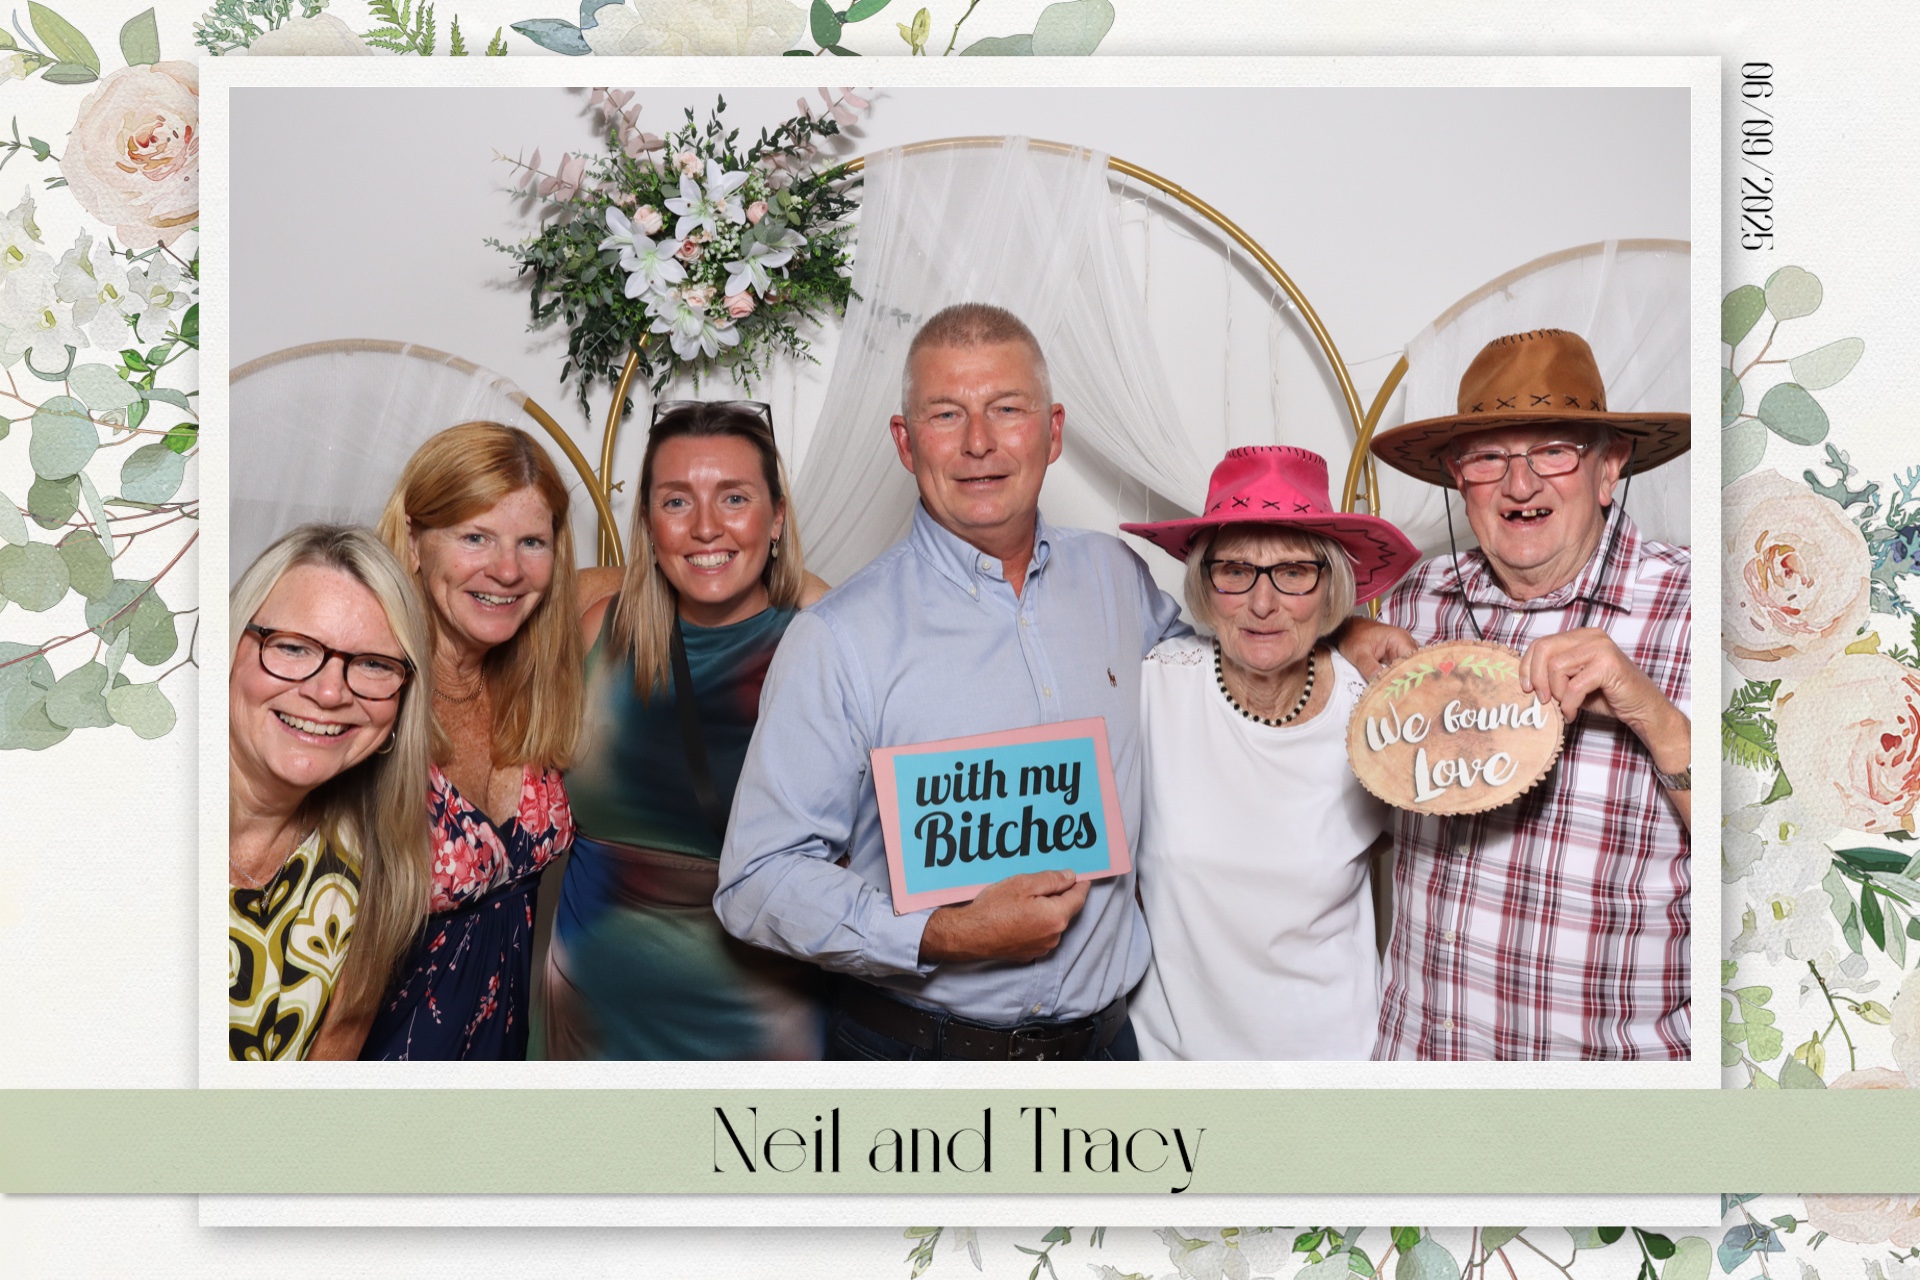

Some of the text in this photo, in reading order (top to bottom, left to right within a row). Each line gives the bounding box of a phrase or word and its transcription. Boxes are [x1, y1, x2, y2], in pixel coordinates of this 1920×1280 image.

[1366, 697, 1549, 751] We found
[915, 759, 1081, 807] with my
[1414, 747, 1519, 803] Love
[914, 805, 1097, 868] Bitches
